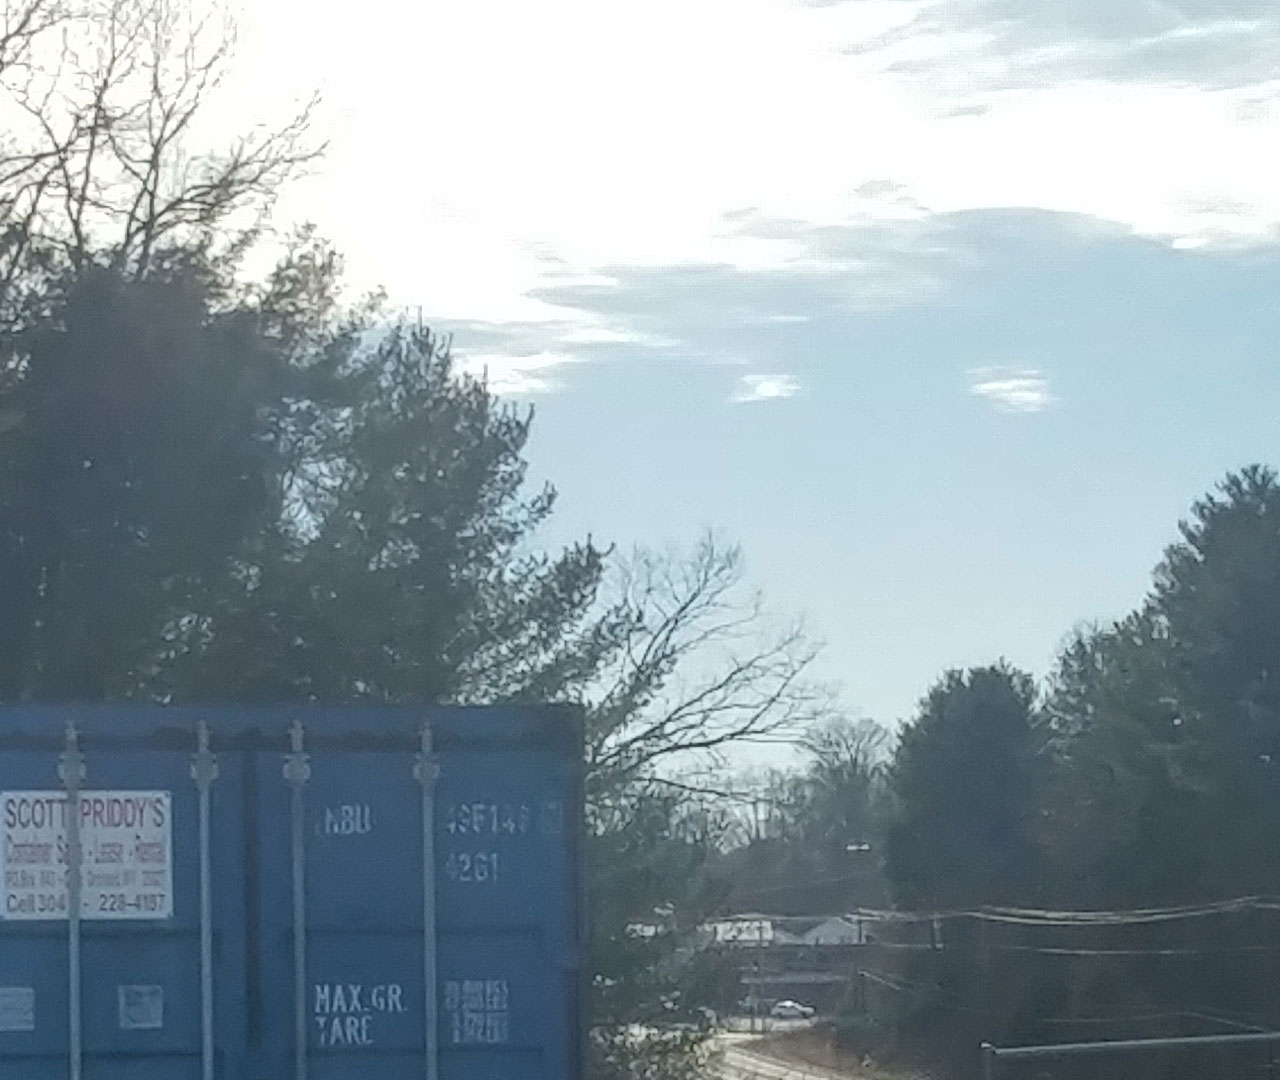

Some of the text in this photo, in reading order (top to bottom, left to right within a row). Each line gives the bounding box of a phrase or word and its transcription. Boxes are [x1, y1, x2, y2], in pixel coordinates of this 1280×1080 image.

[5, 798, 166, 828] SCOTT PRIDDY'S
[6, 894, 35, 914] Cell
[315, 1014, 373, 1046] TARE
